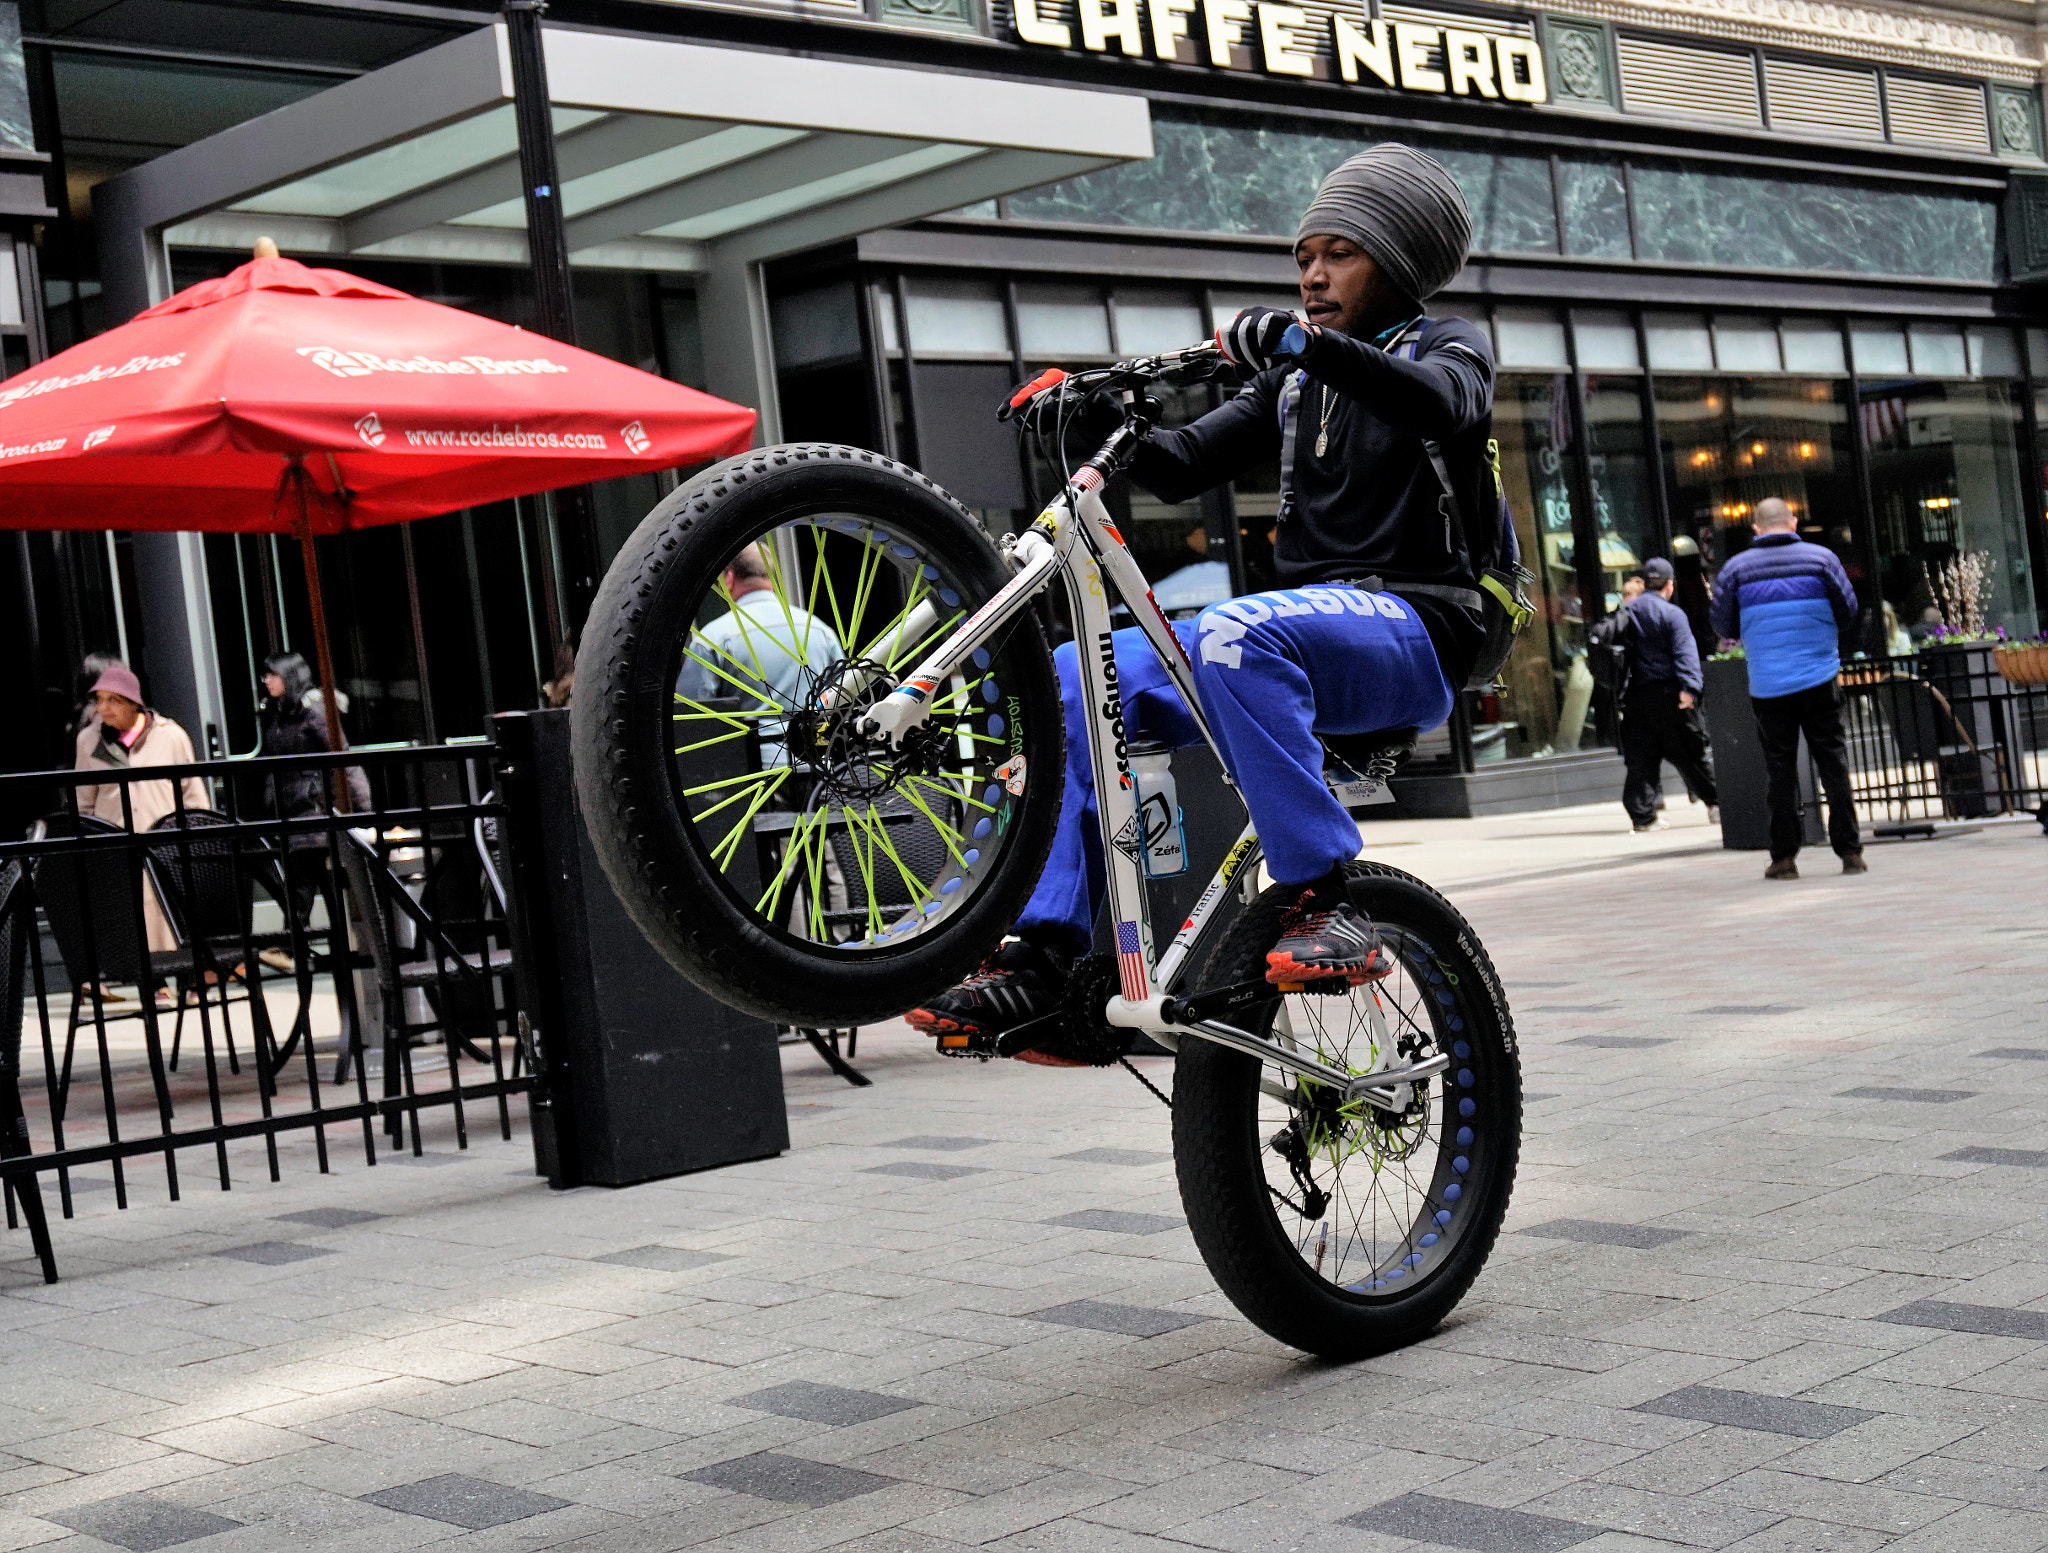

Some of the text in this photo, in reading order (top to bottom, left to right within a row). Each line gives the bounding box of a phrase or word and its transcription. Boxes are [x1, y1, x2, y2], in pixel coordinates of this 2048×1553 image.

[1333, 12, 1547, 103] NERO
[34, 364, 117, 396] Roche
[347, 351, 569, 374] Roche Bros.
[405, 424, 608, 450] www.rochebros.com
[1198, 588, 1408, 669] BOSTON
[1007, 695, 1023, 757] CUSTOM
[1099, 631, 1132, 791] mongoose
[1457, 932, 1512, 1054] Vee Rubber.co.th
